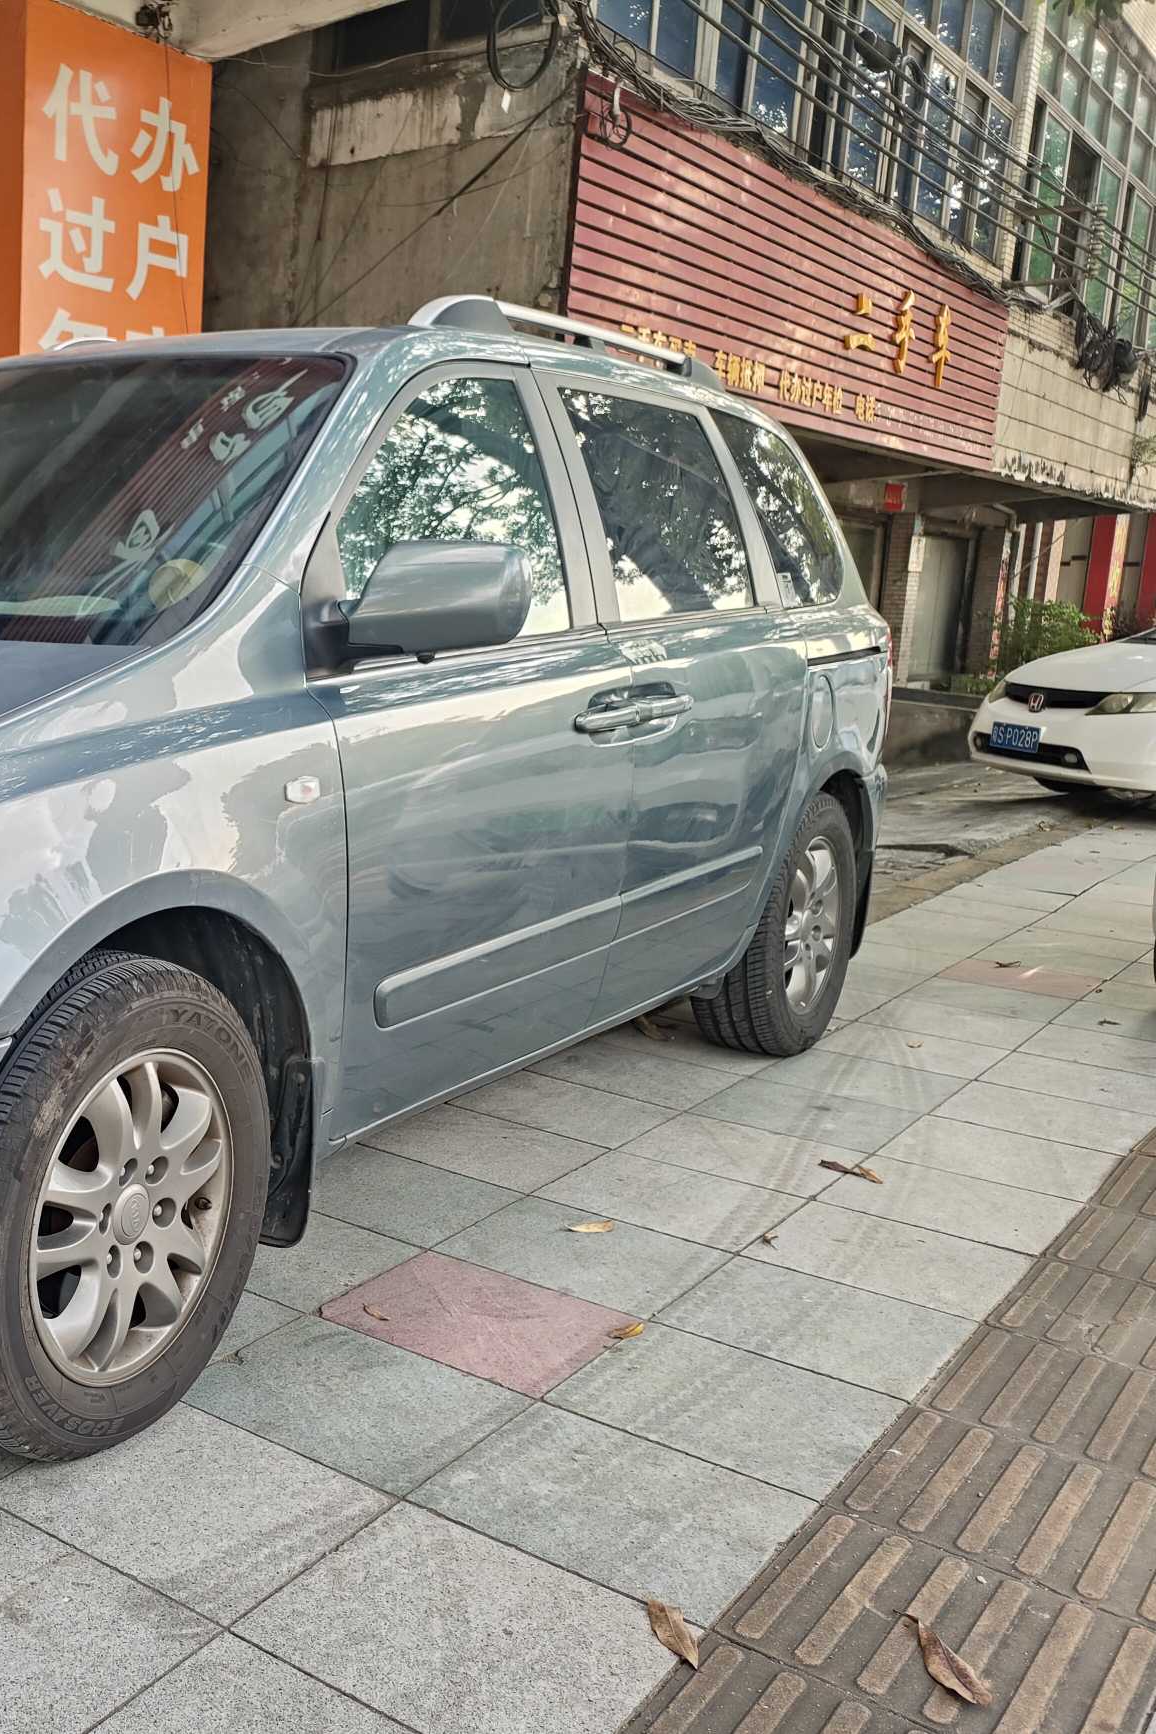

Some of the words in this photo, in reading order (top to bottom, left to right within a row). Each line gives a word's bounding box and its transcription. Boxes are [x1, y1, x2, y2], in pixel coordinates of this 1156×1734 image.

[41, 63, 201, 192] 代办
[38, 188, 189, 301] 过户
[843, 289, 951, 388] 二手车
[24, 1375, 125, 1436] ECOSAVER
